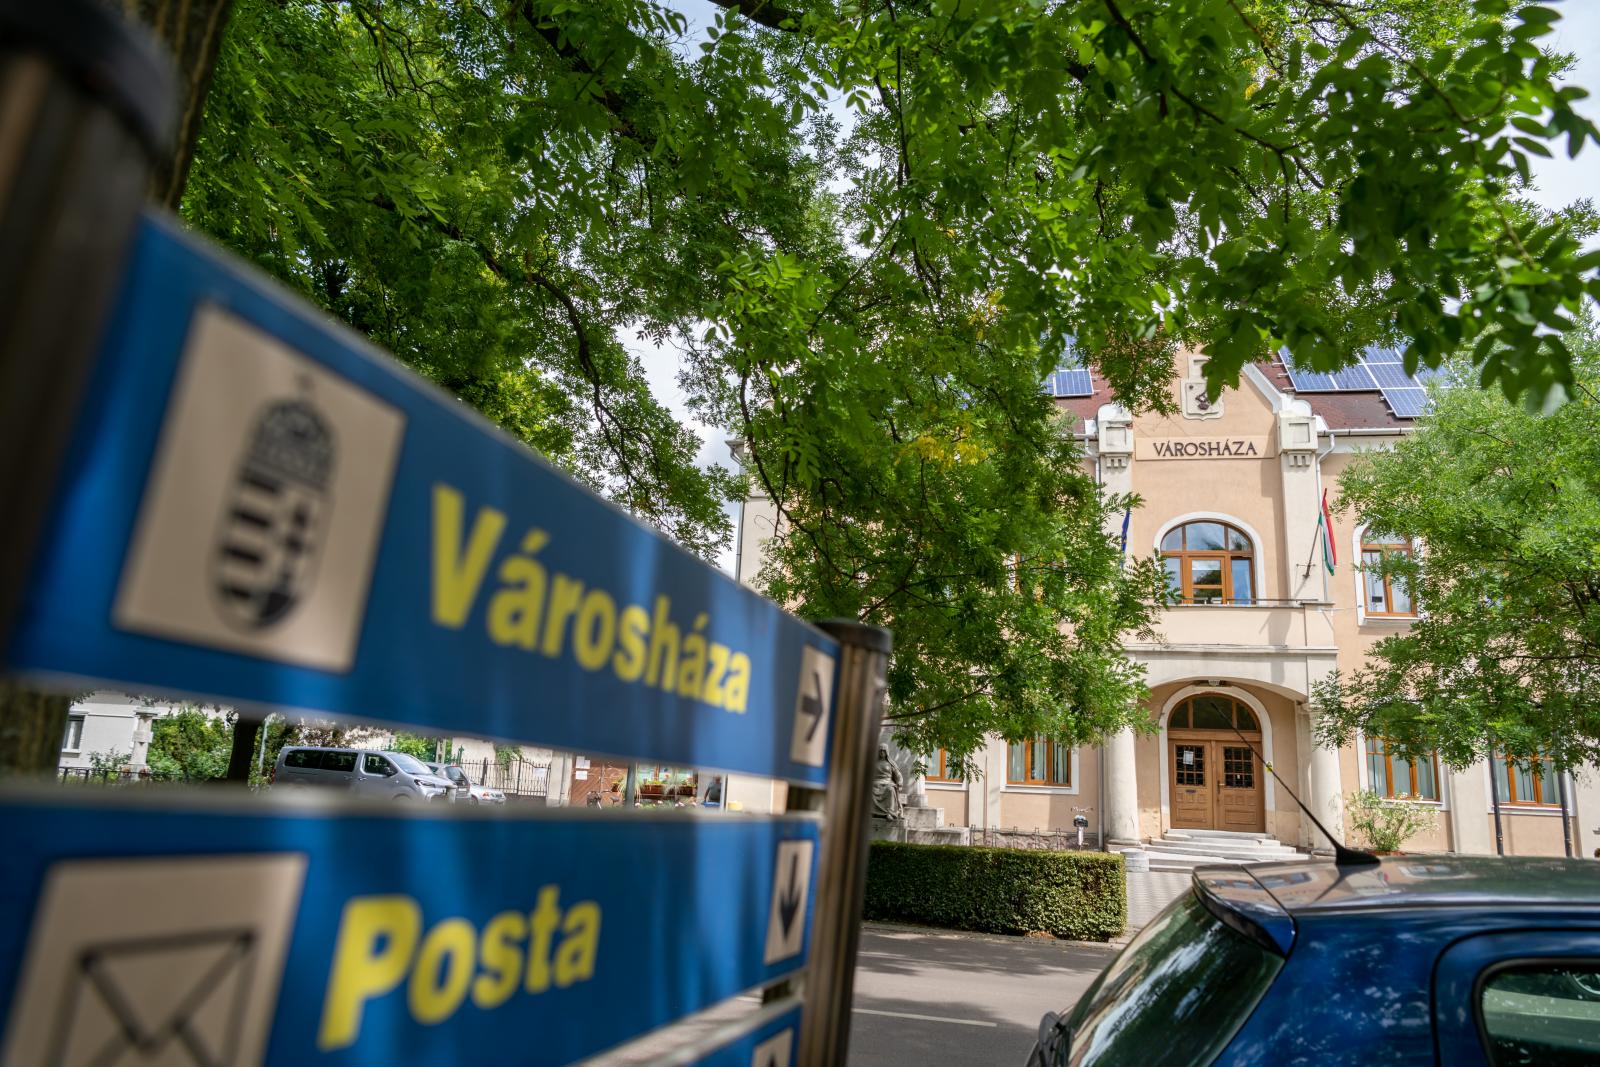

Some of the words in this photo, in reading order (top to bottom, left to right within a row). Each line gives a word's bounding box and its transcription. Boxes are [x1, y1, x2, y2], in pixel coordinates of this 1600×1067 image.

[1153, 439, 1257, 456] VÁROSHÁZA
[432, 481, 751, 713] Városháza
[317, 885, 601, 1051] Posta
